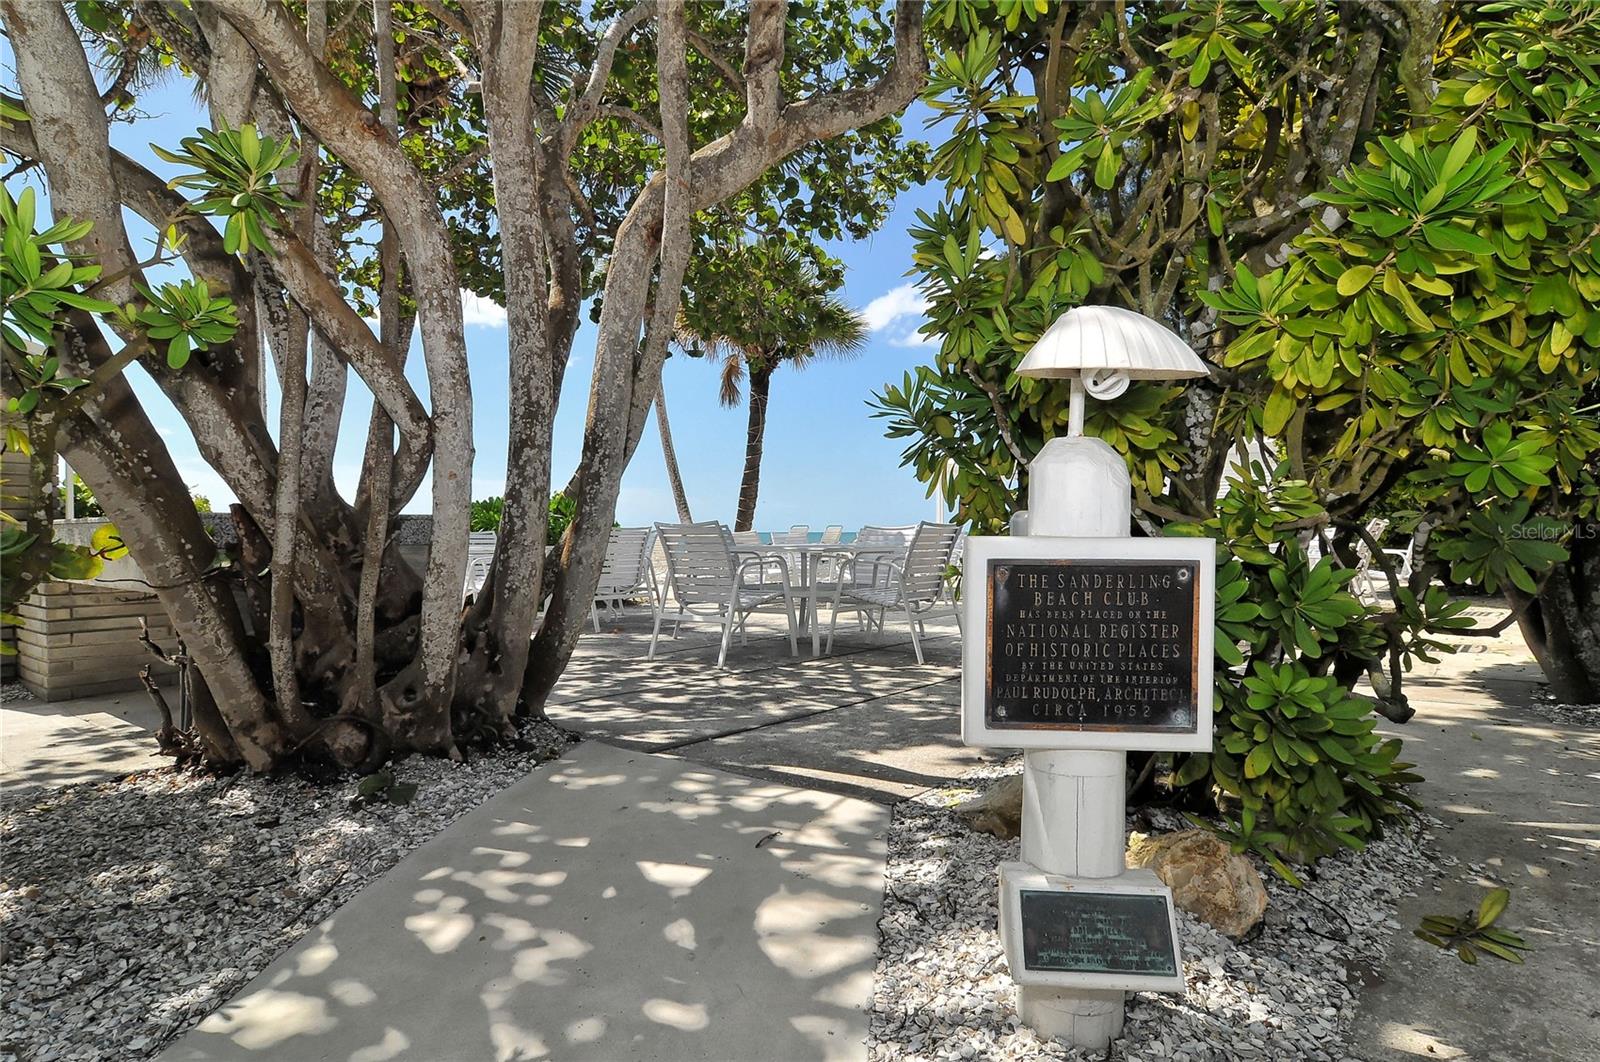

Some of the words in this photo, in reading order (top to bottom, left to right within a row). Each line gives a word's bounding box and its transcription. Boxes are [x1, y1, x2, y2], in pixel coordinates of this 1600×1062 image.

[1018, 574, 1048, 588] THE
[1058, 574, 1171, 588] SANDERLING
[1035, 592, 1092, 606] BEACH
[1048, 611, 1074, 619] BEEN
[1081, 611, 1123, 619] PLACED
[1129, 611, 1141, 619] ON
[1146, 611, 1166, 619] THE
[1006, 624, 1090, 638] NATIONAL
[1100, 624, 1179, 638] REGISTER
[1006, 643, 1024, 657] OF
[1030, 643, 1110, 657] HISTORIC
[1119, 644, 1180, 658] PLACES
[1022, 662, 1033, 671] BY
[1043, 662, 1063, 670] THE
[1070, 662, 1114, 670] UNITED
[1121, 662, 1163, 670] STATES
[1006, 674, 1077, 683] DEPARTMENT
[1083, 675, 1095, 683] OF
[1100, 675, 1120, 683] THE
[997, 687, 1028, 698] PAUL
[1034, 687, 1100, 702] RUDOLPH,
[1033, 704, 1086, 716] CIRCA
[1104, 705, 1150, 717] 1952
